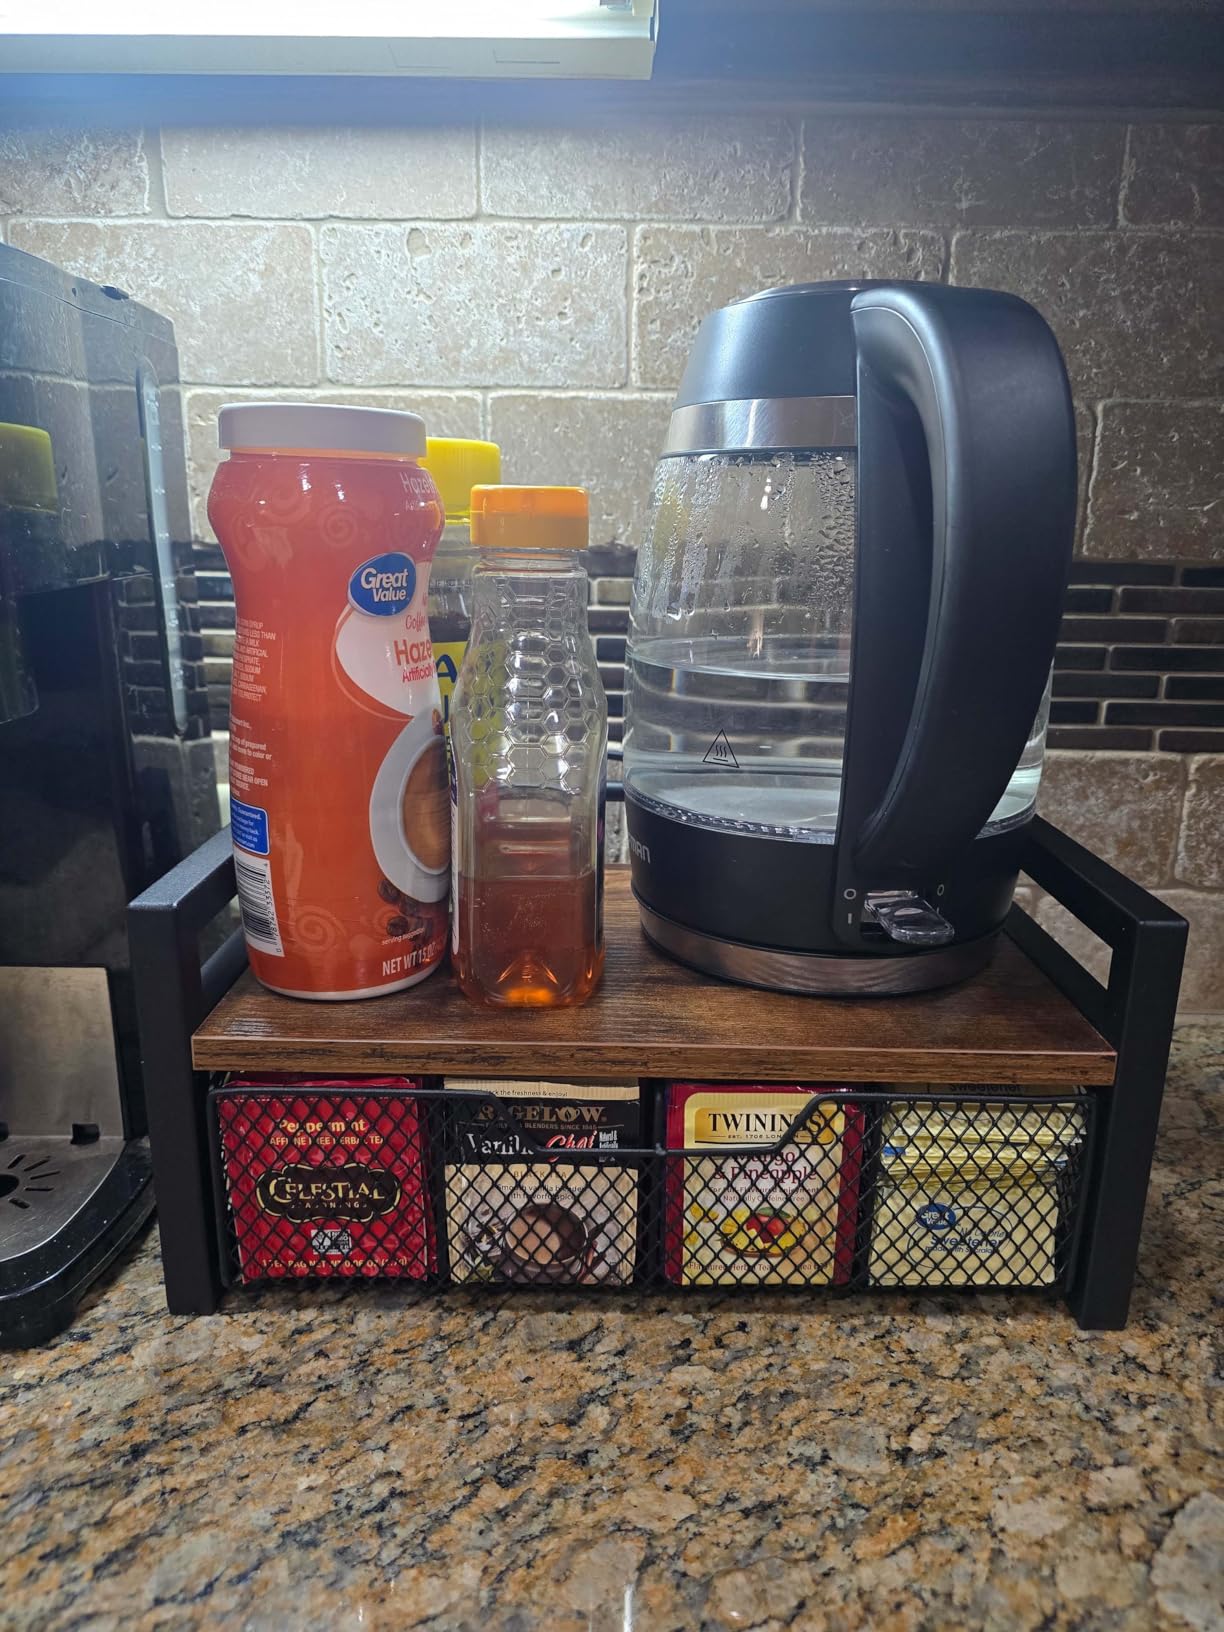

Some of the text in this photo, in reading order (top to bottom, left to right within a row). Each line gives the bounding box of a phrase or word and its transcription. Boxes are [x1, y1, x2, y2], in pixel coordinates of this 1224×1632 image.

[360, 567, 409, 590] Great
[372, 587, 407, 602] Value
[265, 753, 273, 761] or
[382, 957, 402, 977] NET
[403, 950, 417, 970] WT
[477, 1103, 604, 1122] BGELOW
[524, 1122, 558, 1131] BLENDERS
[560, 1123, 580, 1131] SINCE
[708, 1113, 825, 1133] TWININS
[466, 1132, 535, 1155] Vanil
[545, 1130, 599, 1163] Chai
[730, 1166, 818, 1184] Pneapple
[723, 1195, 754, 1203] Natually
[920, 1210, 951, 1219] Gret
[926, 1218, 948, 1226] Vue
